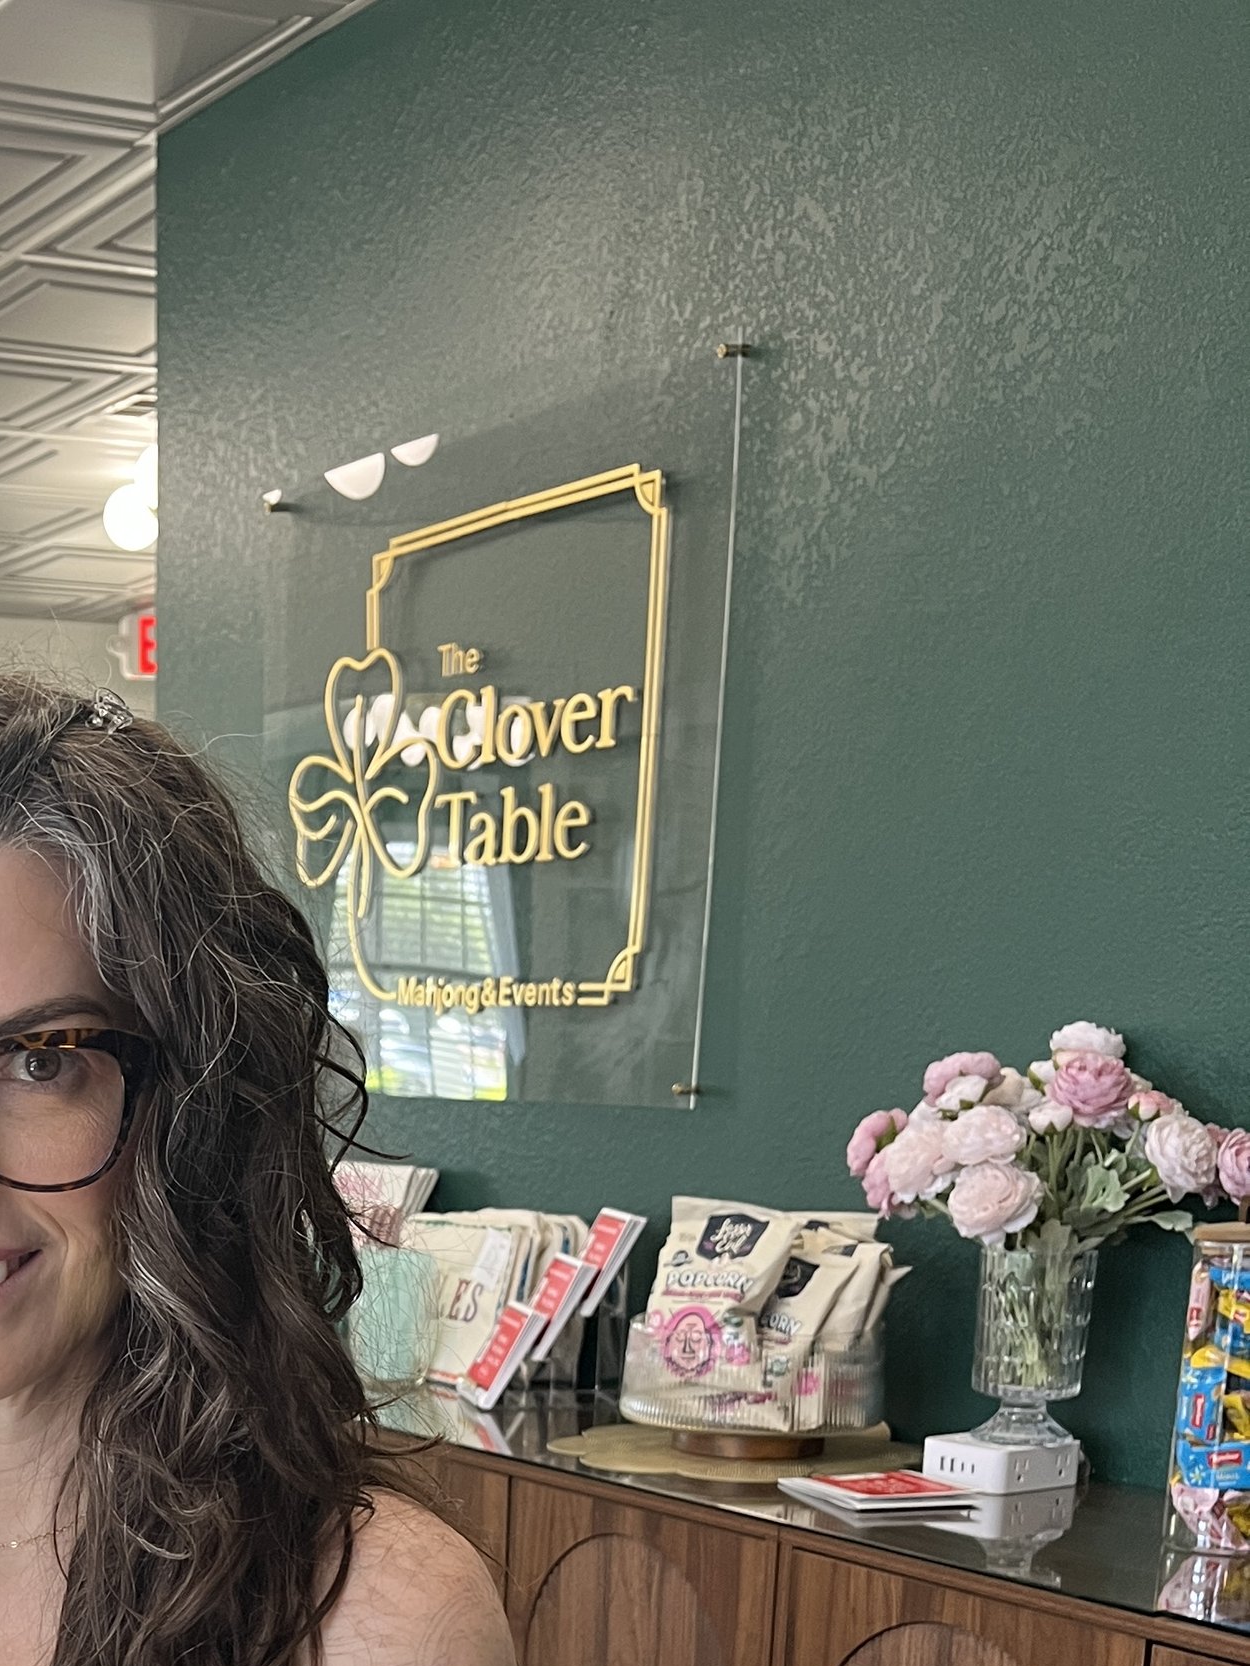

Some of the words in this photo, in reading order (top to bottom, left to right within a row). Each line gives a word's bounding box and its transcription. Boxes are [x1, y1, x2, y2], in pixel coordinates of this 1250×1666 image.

[437, 642, 484, 678] The
[436, 685, 637, 769] Clover
[433, 783, 591, 869] Table
[666, 1271, 754, 1294] POPCORN
